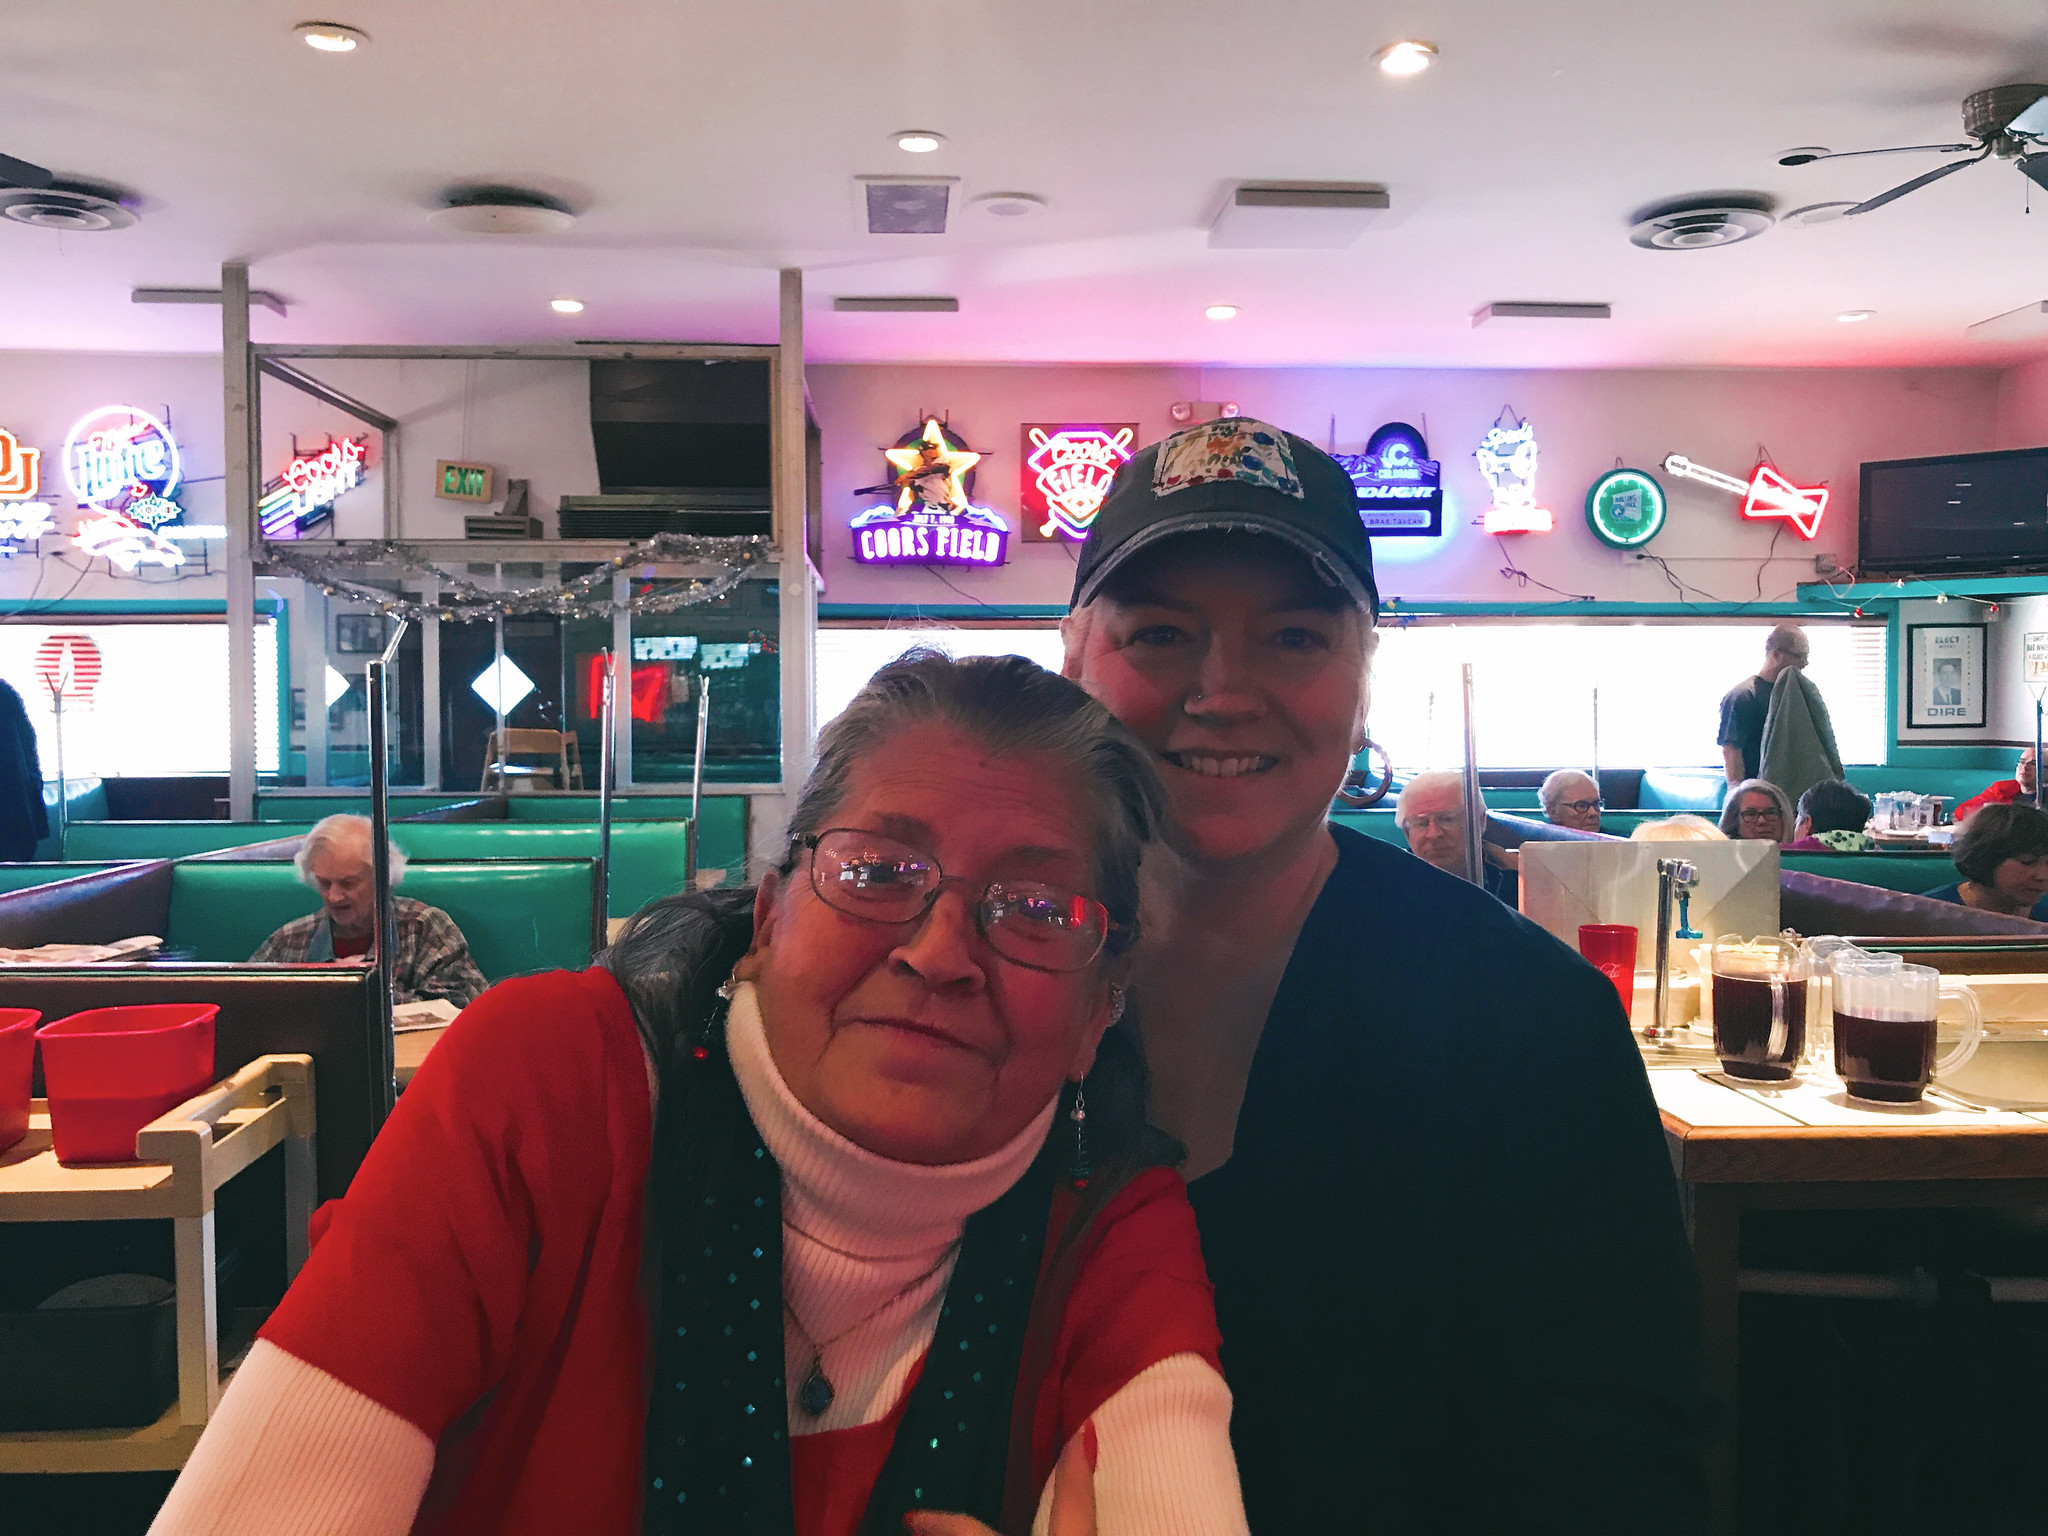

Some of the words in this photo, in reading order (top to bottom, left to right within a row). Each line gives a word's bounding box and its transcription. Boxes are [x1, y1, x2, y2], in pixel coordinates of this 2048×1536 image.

[282, 437, 365, 491] Coors
[1051, 438, 1116, 464] Coors
[444, 465, 485, 496] EXIT
[1046, 464, 1113, 496] FIELD
[1376, 485, 1436, 498] LIGHT
[861, 526, 929, 560] COORS
[936, 527, 1000, 562] FIELD
[1934, 635, 1960, 644] ELECT
[1927, 707, 1967, 717] DIRE
